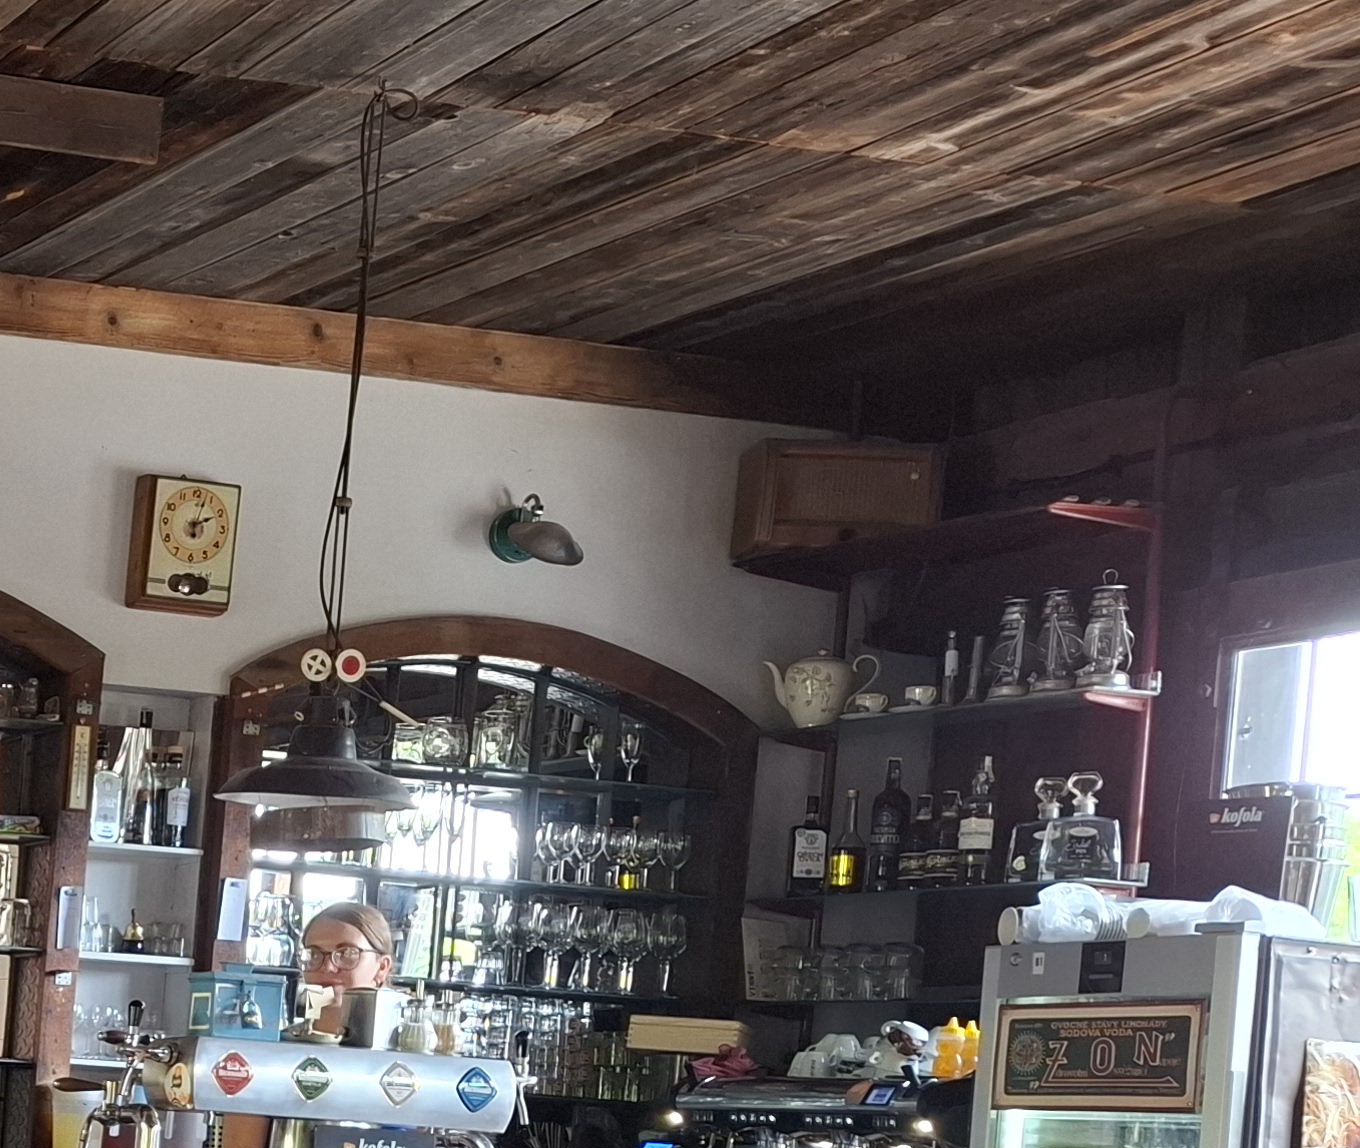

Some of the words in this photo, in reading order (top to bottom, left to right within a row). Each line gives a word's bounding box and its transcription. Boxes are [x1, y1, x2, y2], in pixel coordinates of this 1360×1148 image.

[192, 489, 202, 499] 12
[167, 502, 177, 511] 10
[217, 508, 224, 518] 2
[163, 517, 169, 526] 9
[219, 525, 225, 534] 3
[165, 533, 171, 542] 8
[213, 540, 220, 549] 4
[173, 547, 179, 556] 7
[202, 550, 208, 560] 5
[188, 553, 194, 562] 6
[1220, 806, 1263, 827] kofola
[1104, 1027, 1134, 1037] VODA
